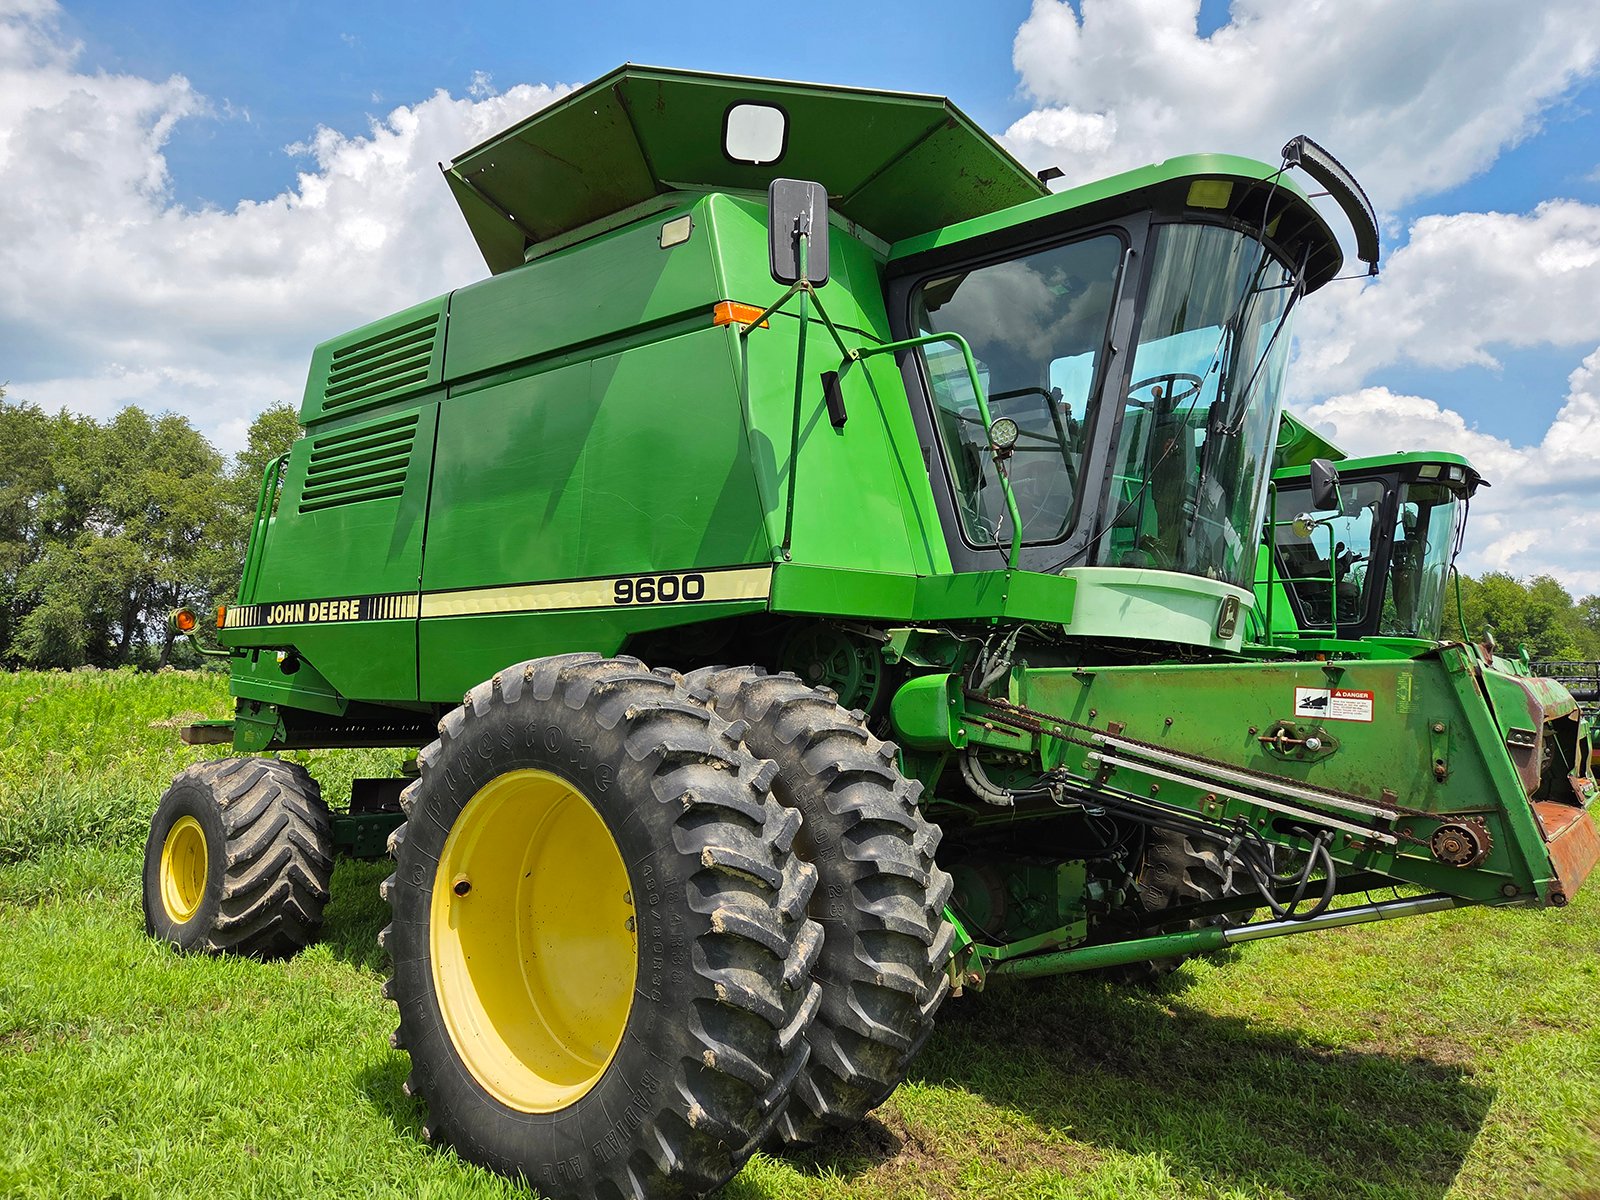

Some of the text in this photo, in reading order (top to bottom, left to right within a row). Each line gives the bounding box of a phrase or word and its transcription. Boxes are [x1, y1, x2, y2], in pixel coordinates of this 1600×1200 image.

[613, 574, 705, 604] 9600
[266, 599, 361, 625] JOHN DEERE
[1342, 691, 1369, 699] DANGER
[592, 1068, 660, 1163] RADIAL
